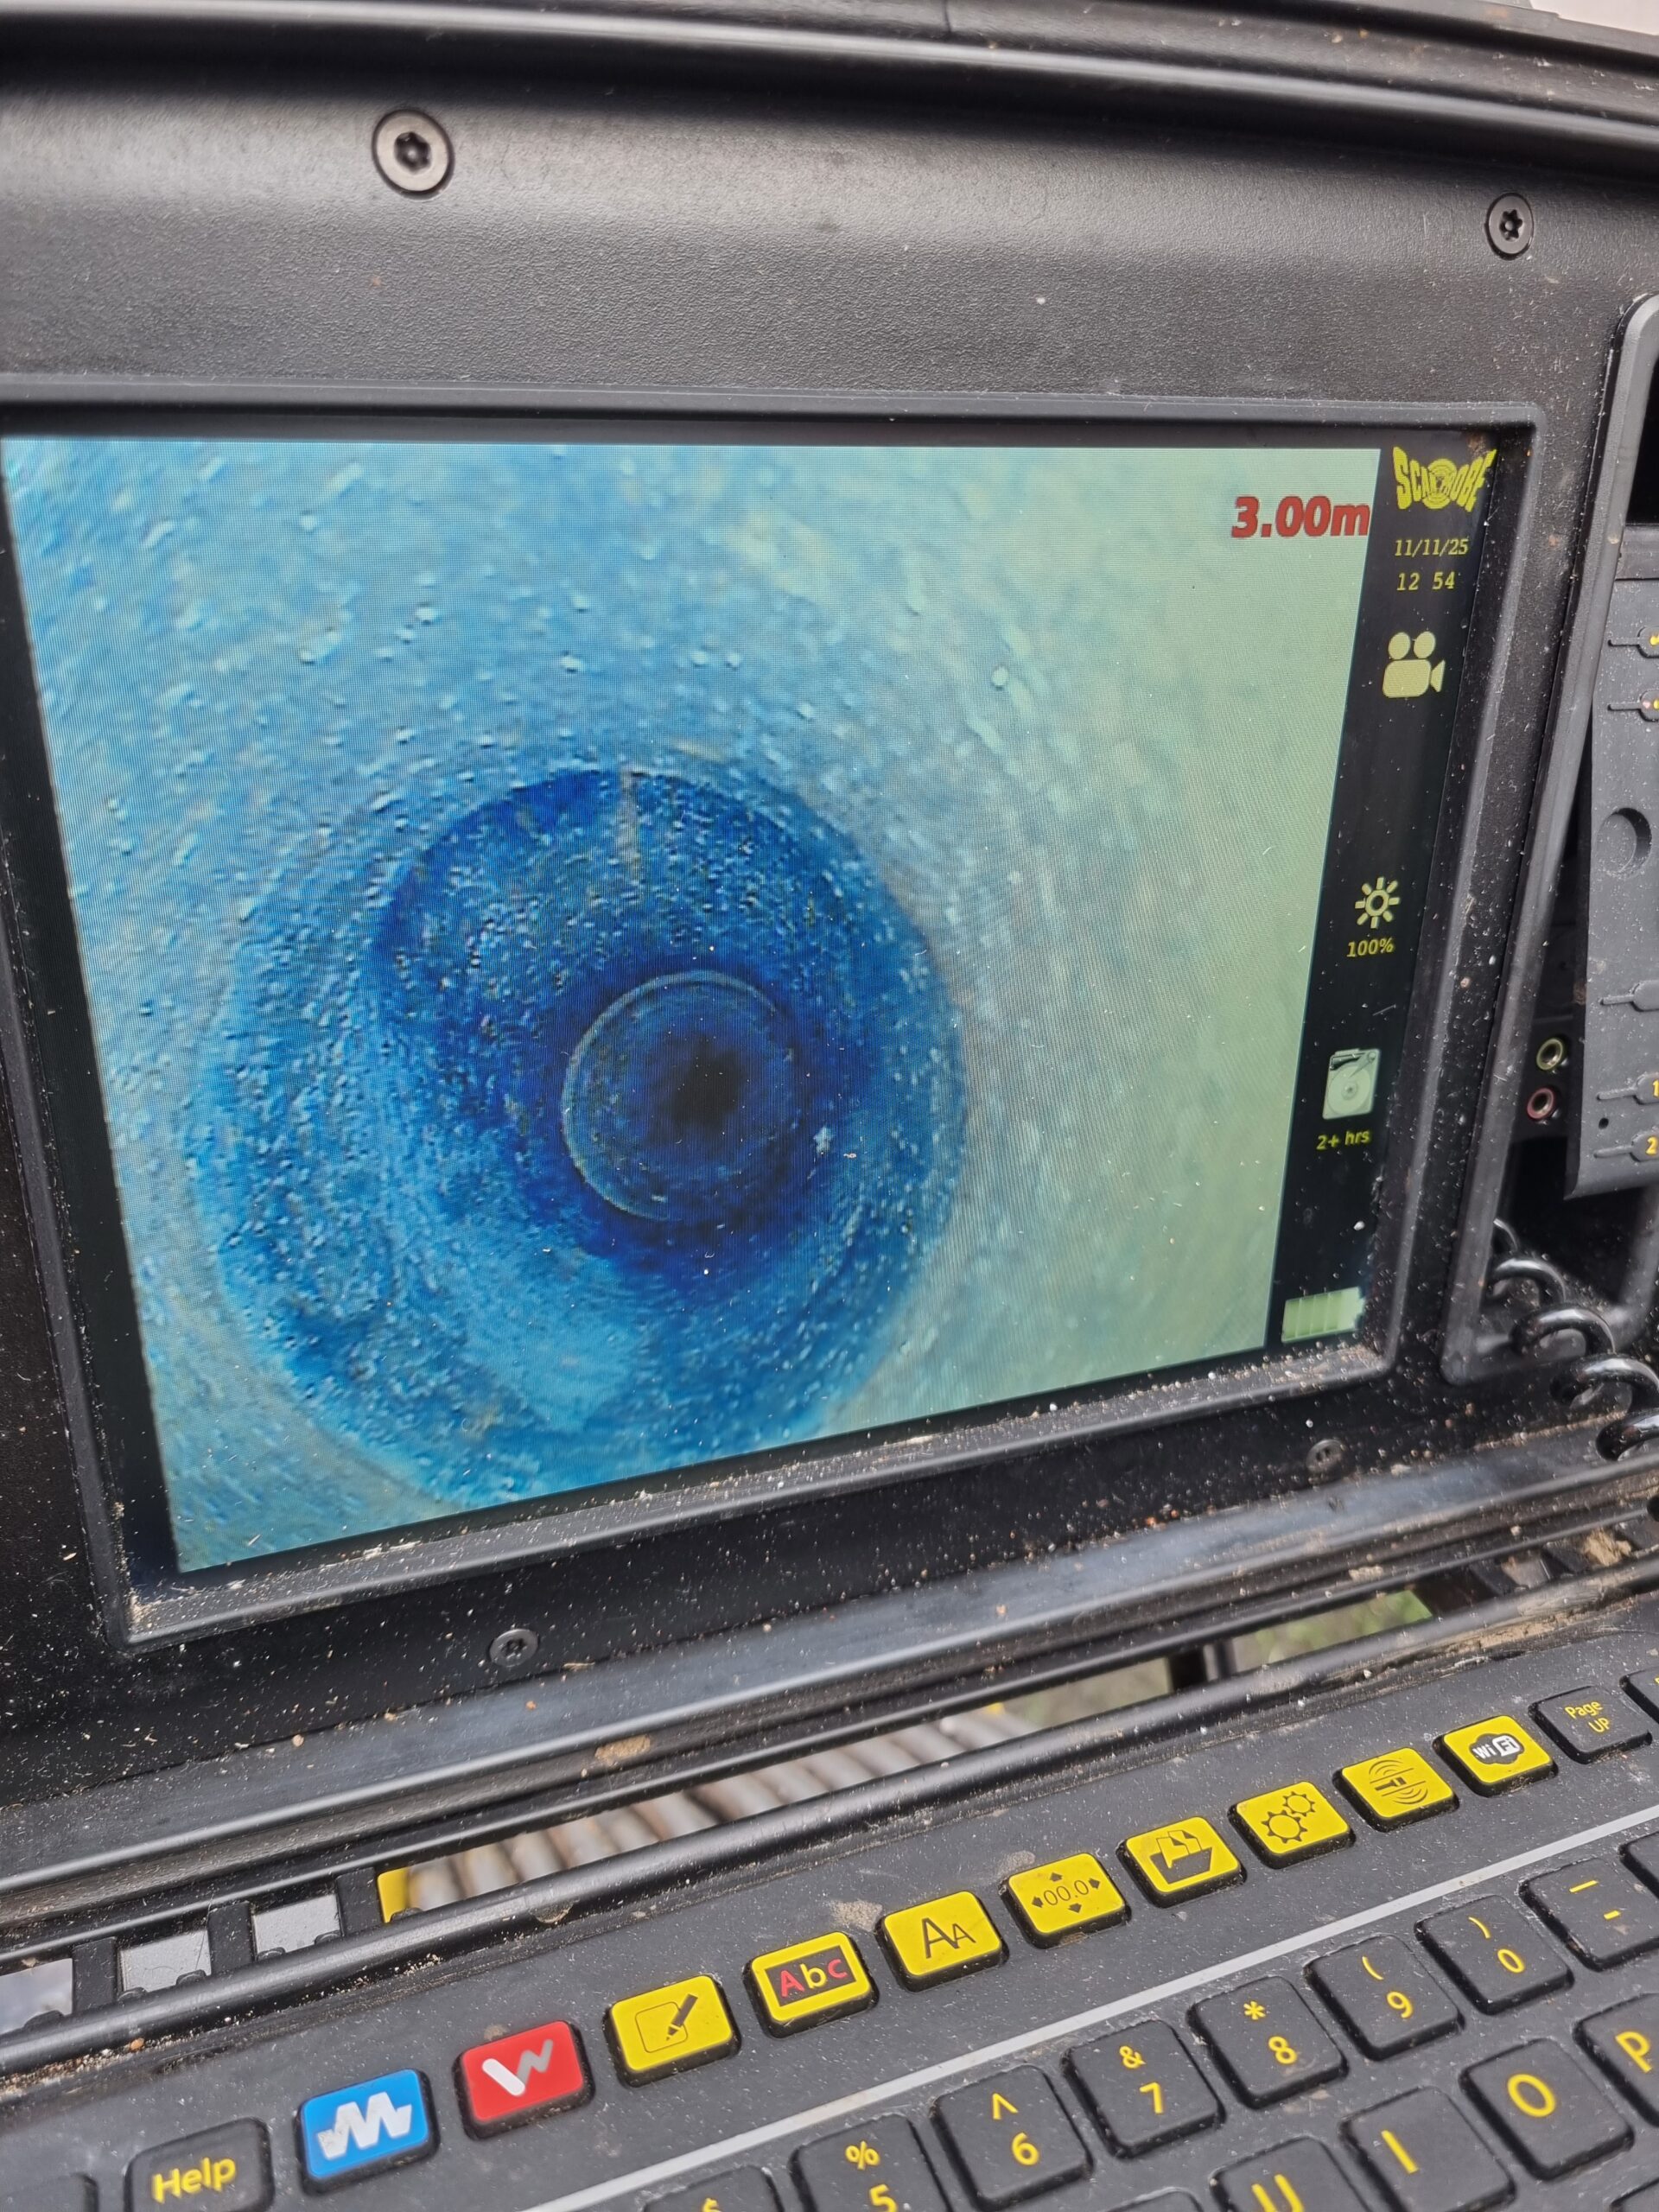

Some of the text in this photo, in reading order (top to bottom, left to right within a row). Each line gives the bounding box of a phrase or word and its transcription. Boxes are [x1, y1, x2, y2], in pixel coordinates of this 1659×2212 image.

[1231, 496, 1370, 538] 3.00m
[1395, 538, 1469, 557] 11/11/25
[1346, 938, 1395, 957] 100%
[1316, 1131, 1370, 1150] 2+ hrs
[1565, 1701, 1603, 1719] Page
[1588, 1717, 1610, 1732] UP
[1043, 1879, 1090, 1906] 00.0
[1498, 1949, 1524, 1973] 0
[779, 1958, 848, 1998] Abc
[1387, 1991, 1413, 2018] 9
[1119, 2045, 1146, 2069] &
[1268, 2036, 1297, 2064] 8
[1615, 2031, 1652, 2073] P
[1139, 2082, 1163, 2114] 7
[1507, 2074, 1556, 2118] O
[845, 2141, 880, 2170] %
[1011, 2133, 1039, 2165] 6
[153, 2157, 236, 2204] Help
[870, 2184, 897, 2212] 5
